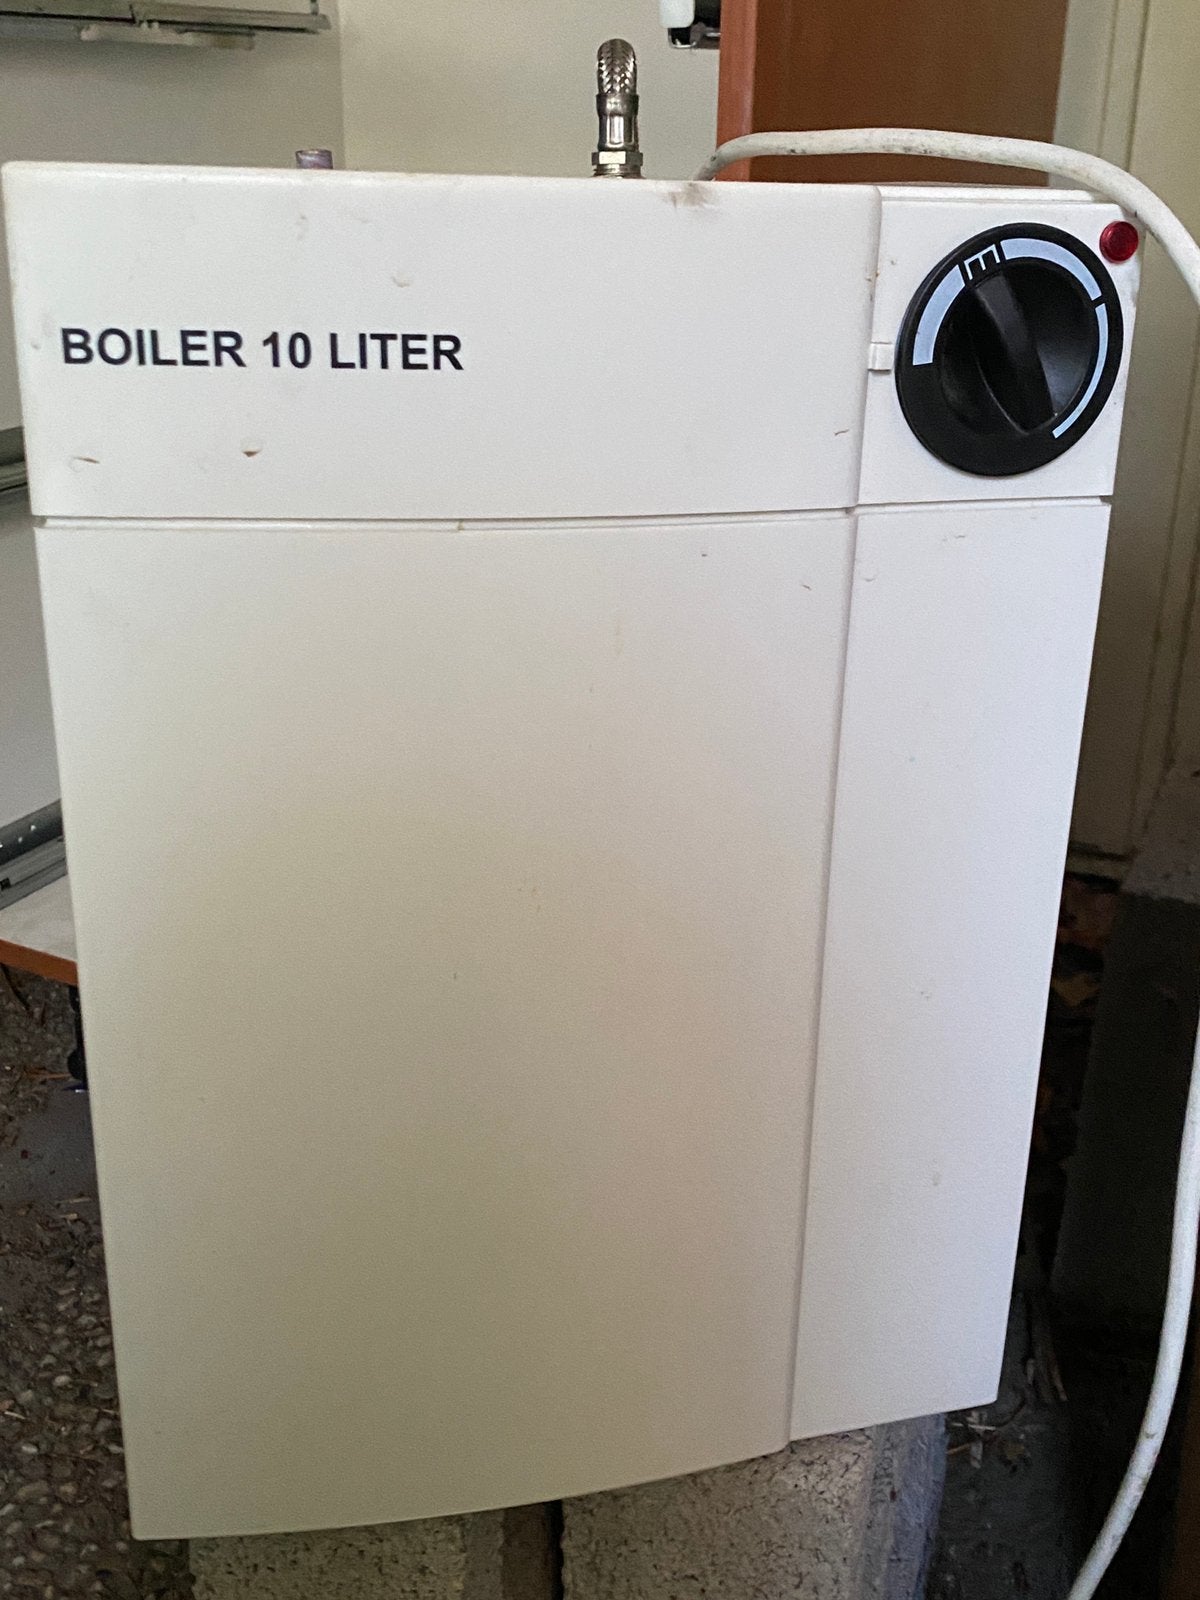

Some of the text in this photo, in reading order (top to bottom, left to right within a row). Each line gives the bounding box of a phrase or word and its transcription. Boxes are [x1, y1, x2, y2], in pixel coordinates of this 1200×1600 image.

[61, 327, 464, 371] BOILER 10 LITER
